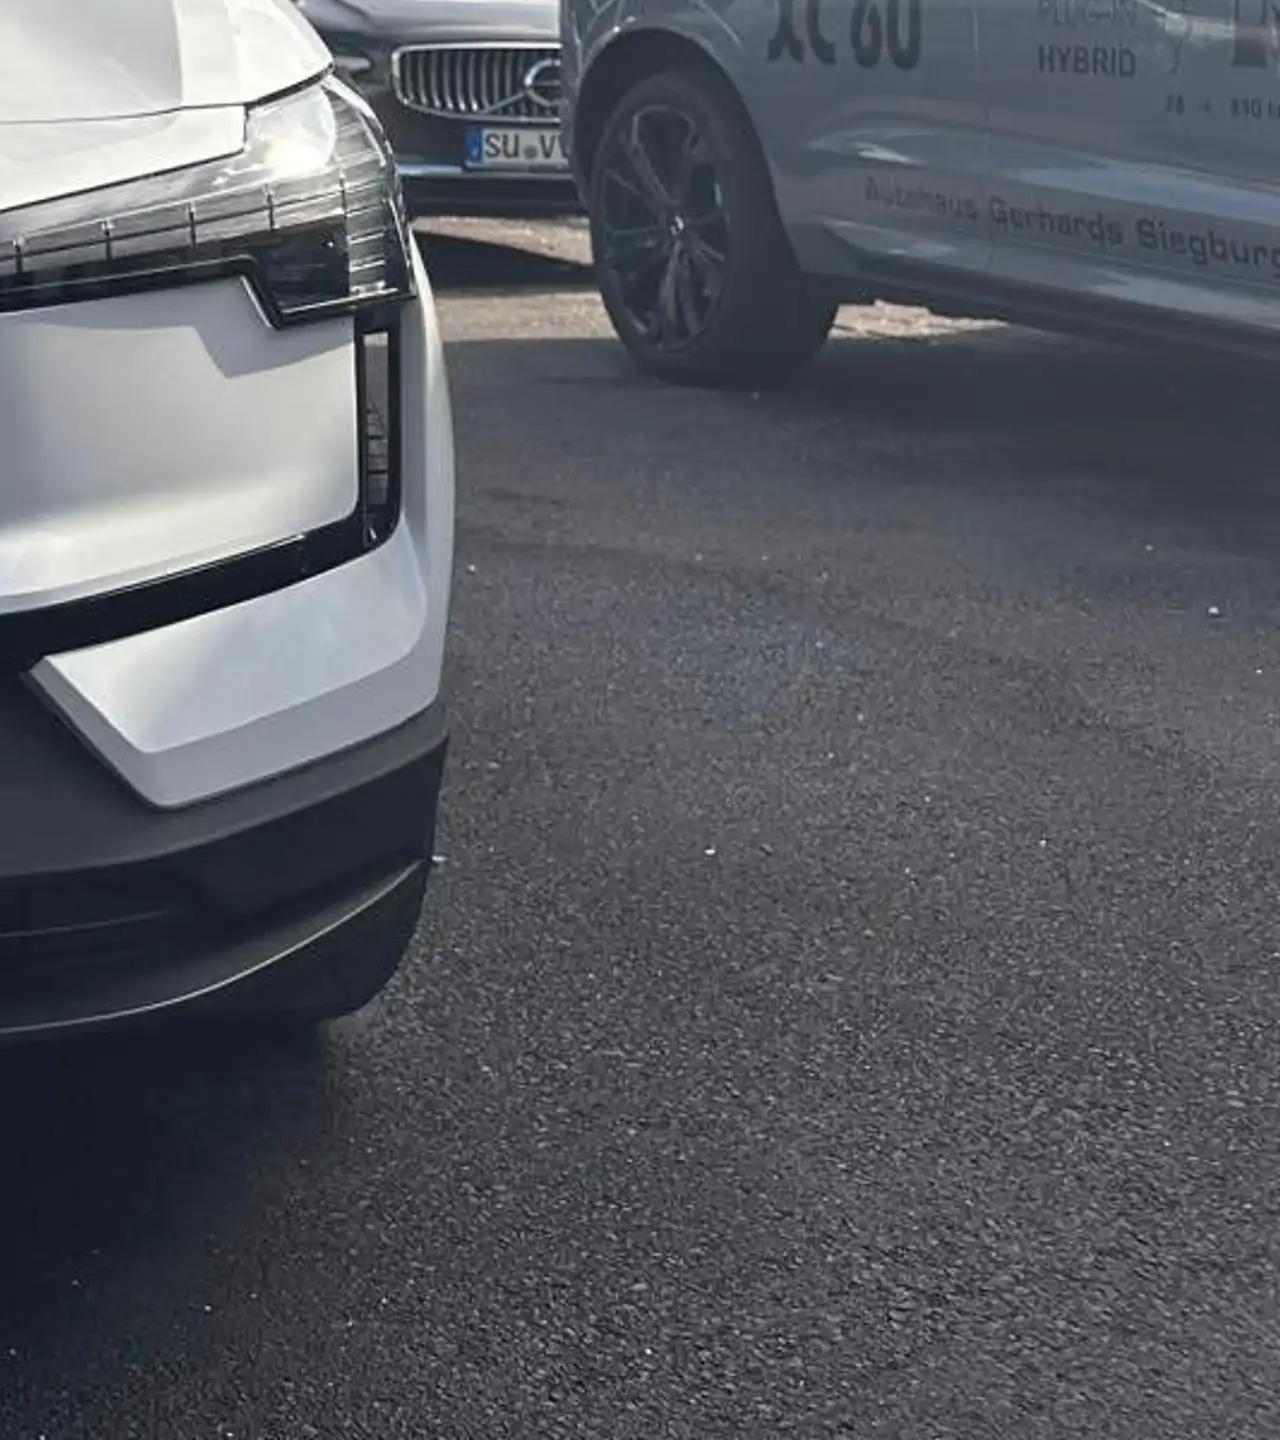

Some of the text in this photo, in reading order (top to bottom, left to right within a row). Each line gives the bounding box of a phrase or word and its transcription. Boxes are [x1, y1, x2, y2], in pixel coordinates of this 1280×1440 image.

[1037, 44, 1137, 78] HYBRID
[484, 133, 521, 159] SU
[864, 174, 980, 223] Autohaus
[988, 196, 1124, 246] Gerhards
